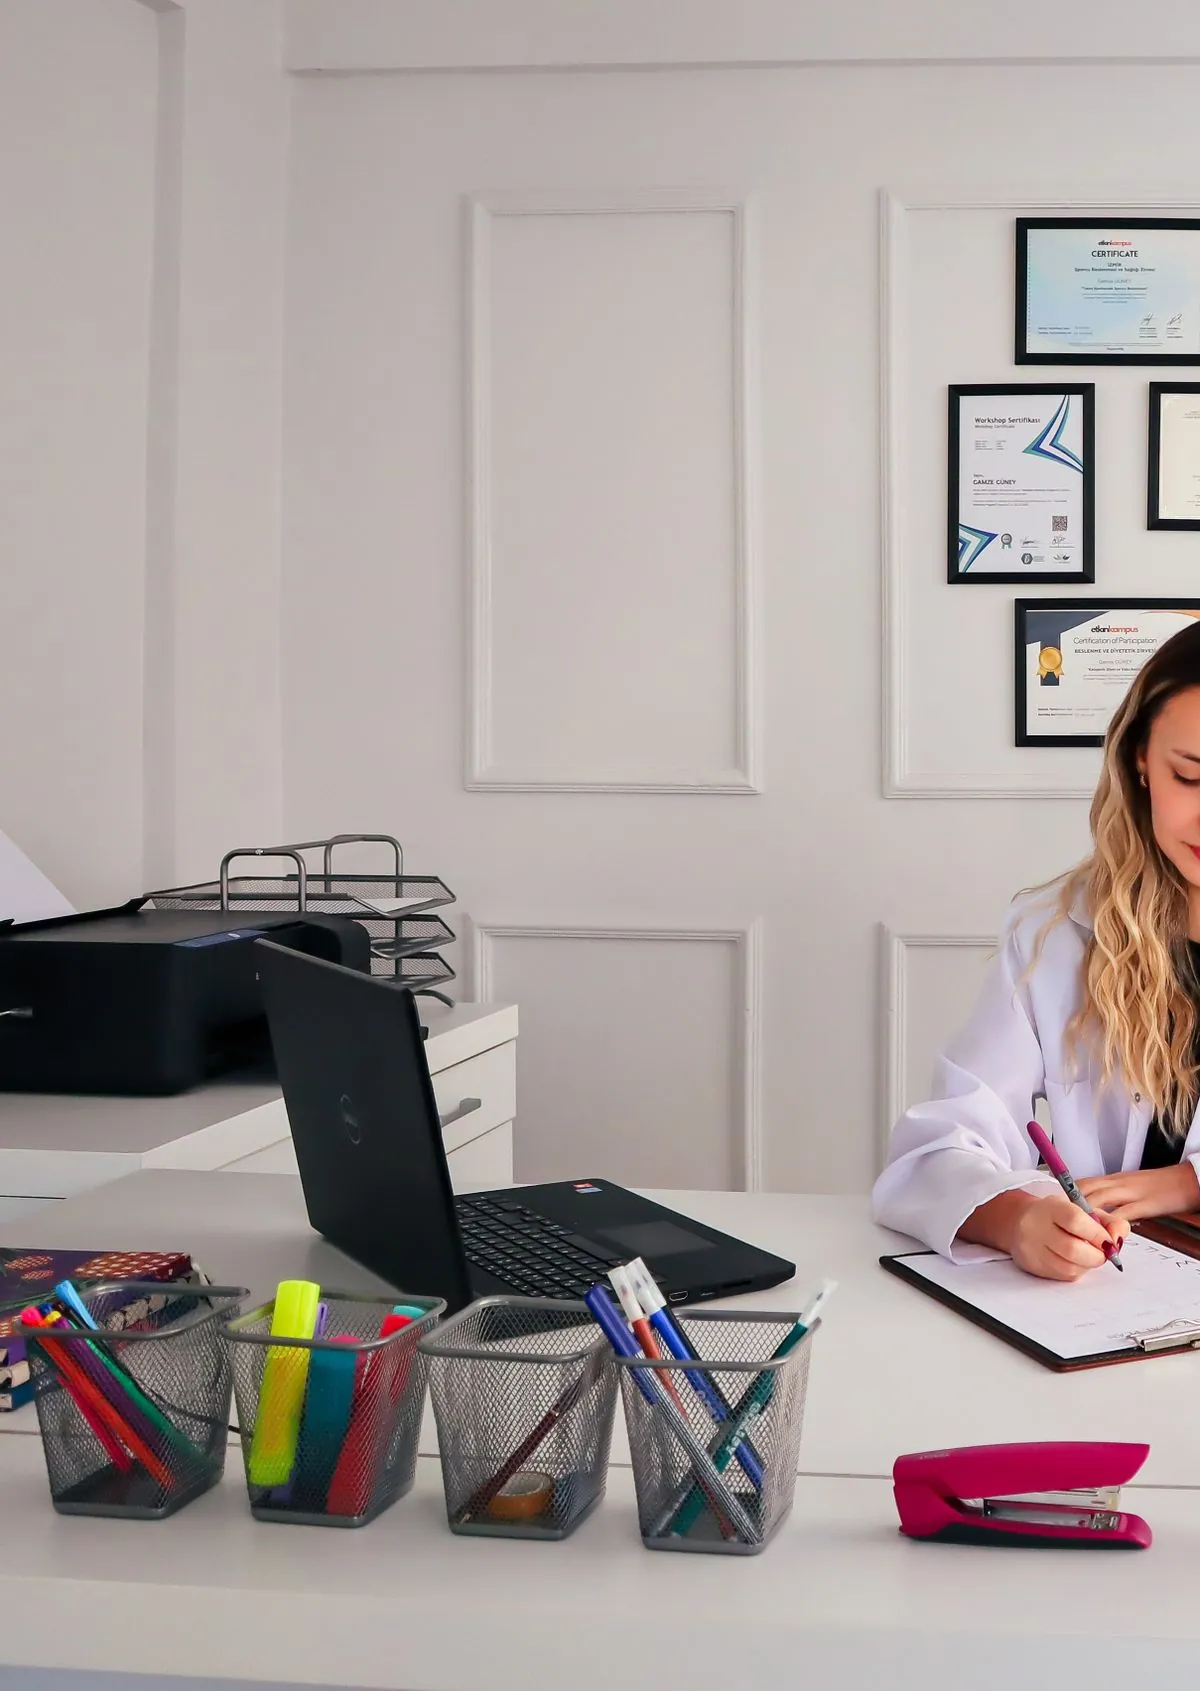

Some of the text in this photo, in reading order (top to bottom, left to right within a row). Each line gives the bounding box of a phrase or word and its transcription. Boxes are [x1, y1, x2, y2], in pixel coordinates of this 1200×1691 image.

[1091, 250, 1139, 258] CERTIFICATE
[1073, 637, 1111, 645] Certification
[1118, 637, 1157, 645] Participation
